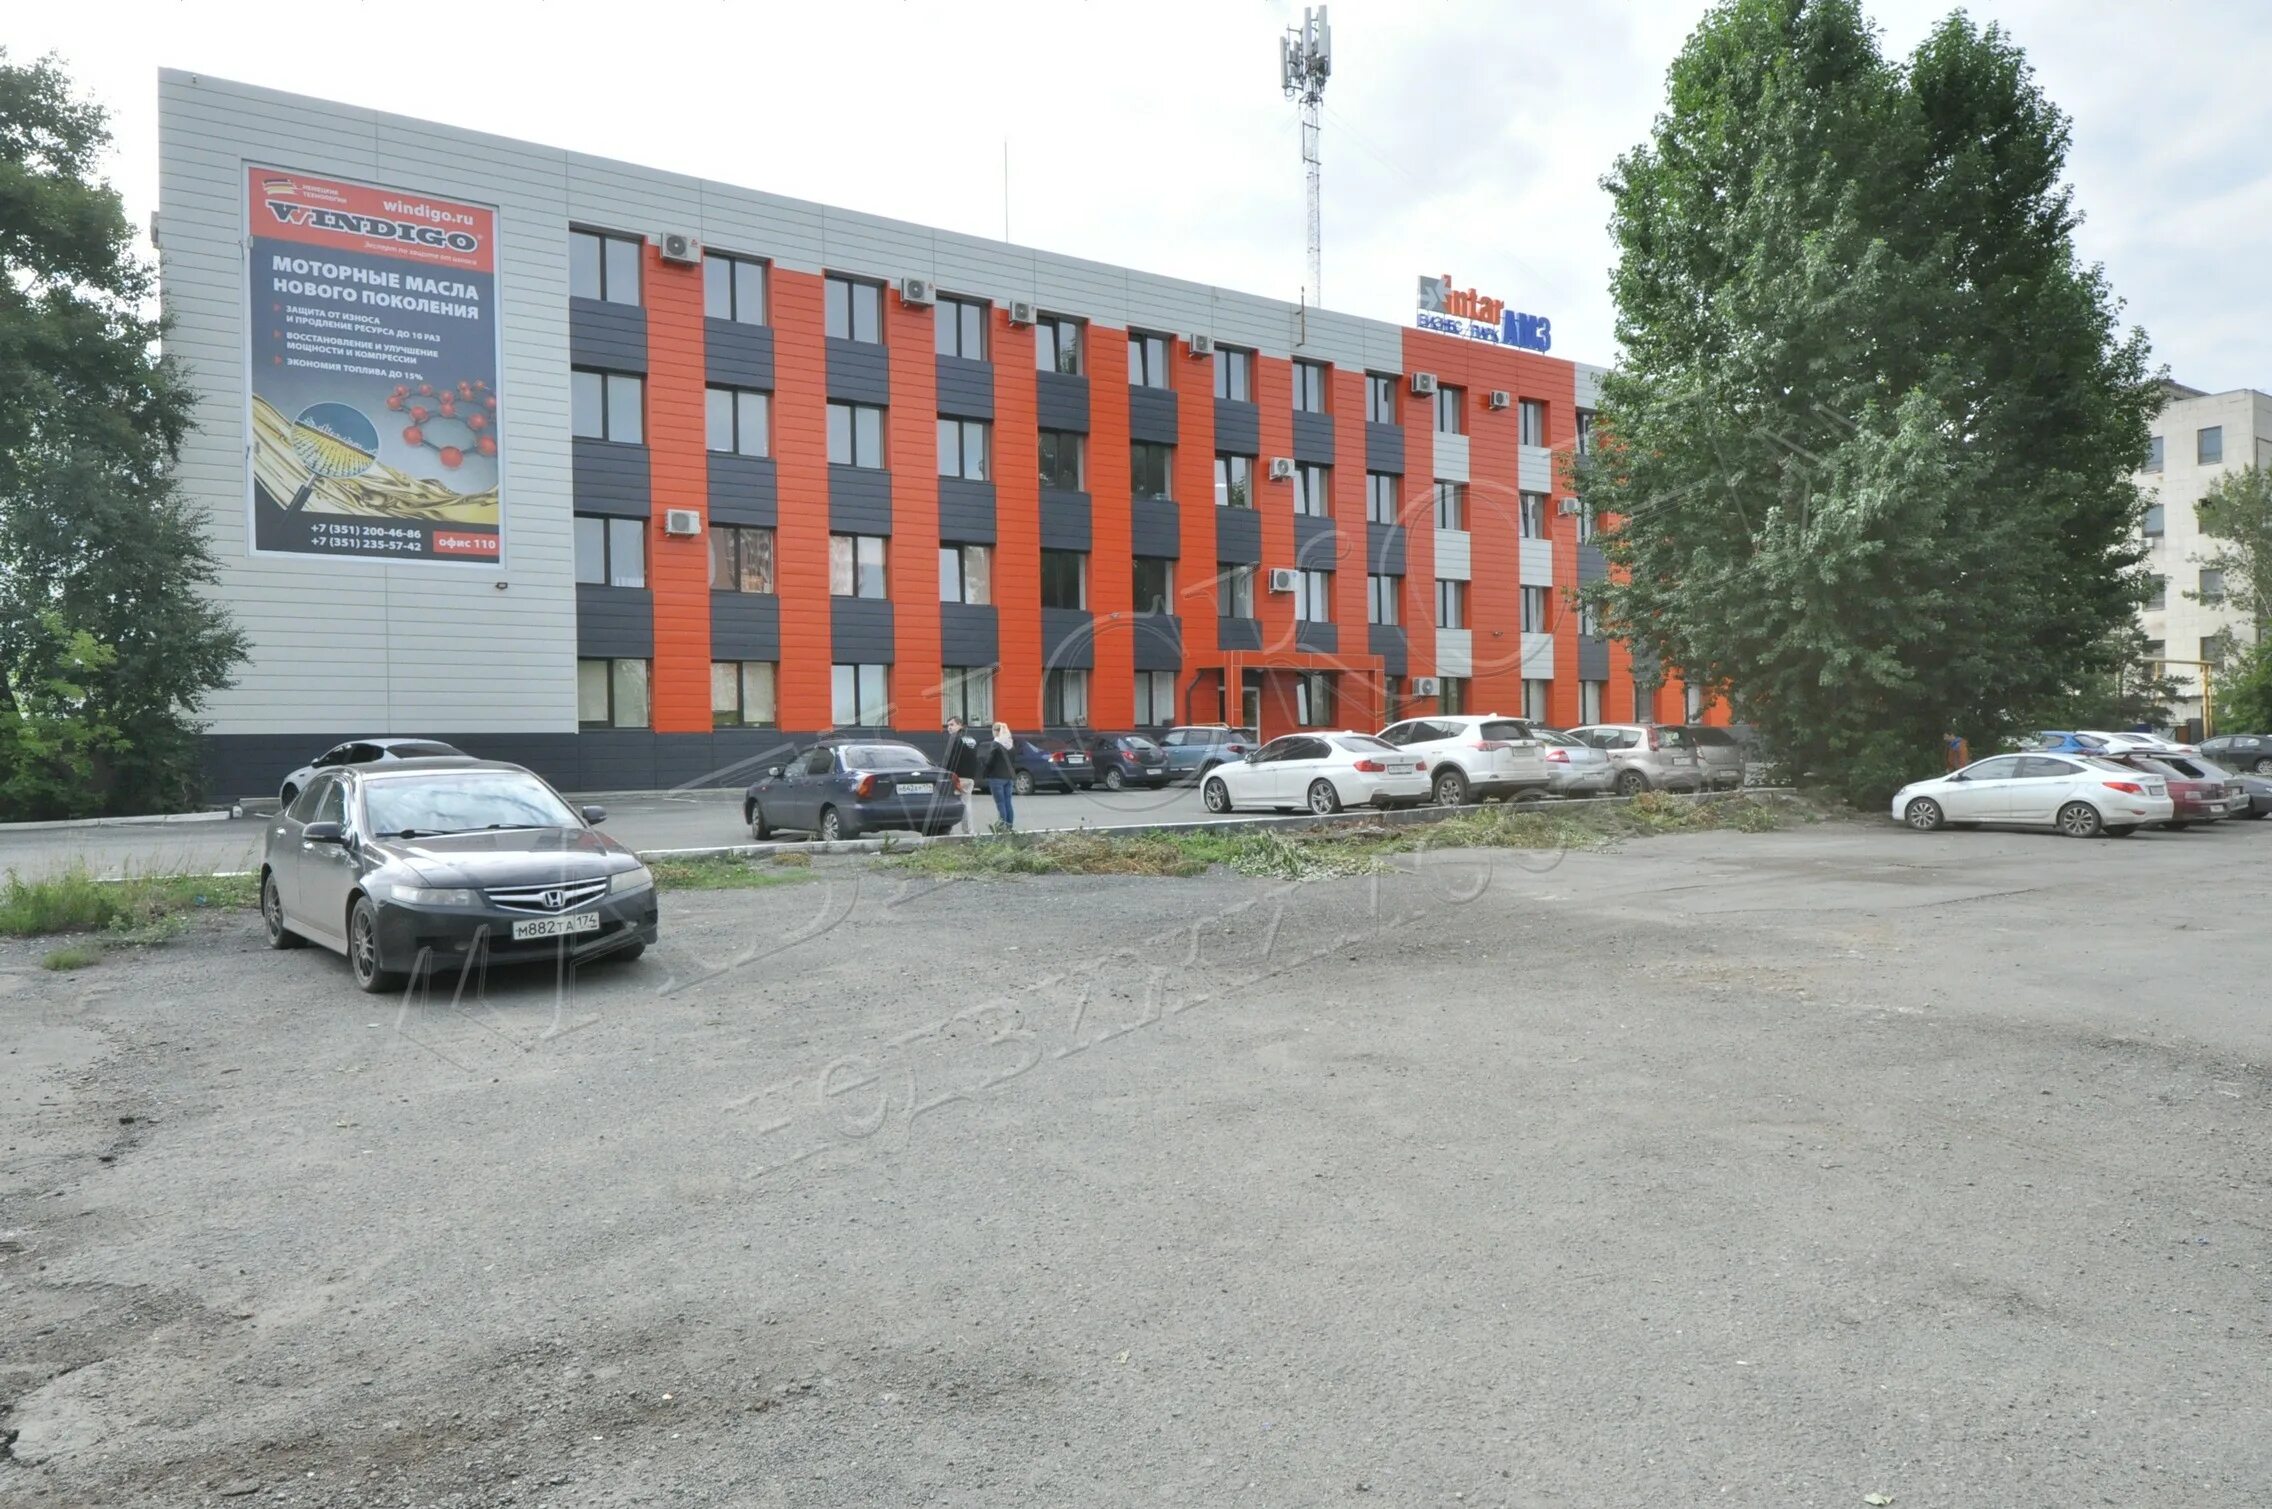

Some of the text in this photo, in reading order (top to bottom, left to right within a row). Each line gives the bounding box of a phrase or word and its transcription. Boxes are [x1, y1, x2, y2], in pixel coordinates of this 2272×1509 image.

[265, 199, 478, 253] WINDIGO
[383, 199, 475, 227] windigo.ru
[272, 256, 479, 301] МОТОРНЫЕ МАСЛА
[273, 278, 479, 320] НОВОГО ПОКОЛЕНИЯ
[286, 305, 380, 325] ЗАЩИТА ОТ ИЗНОСА
[286, 315, 441, 342] И ПРОДЛЕНИЕ РЕСУРСА ДО 10 РАЗ
[1503, 309, 1552, 352] АМЗ
[286, 332, 439, 358] ВОССТАНОВЛЕНИЕ И УЛУЧШЕНИЕ
[286, 342, 417, 364] МОЩНОСТИ И КОМПРЕССИИ
[287, 358, 423, 381] ЭКОНОМИЯ ТОПЛИВА ДО 15%
[310, 524, 422, 539] +7 (351) 200-46-86
[310, 537, 422, 552] +7 (351) 235-57-42
[438, 538, 496, 550] офис 110
